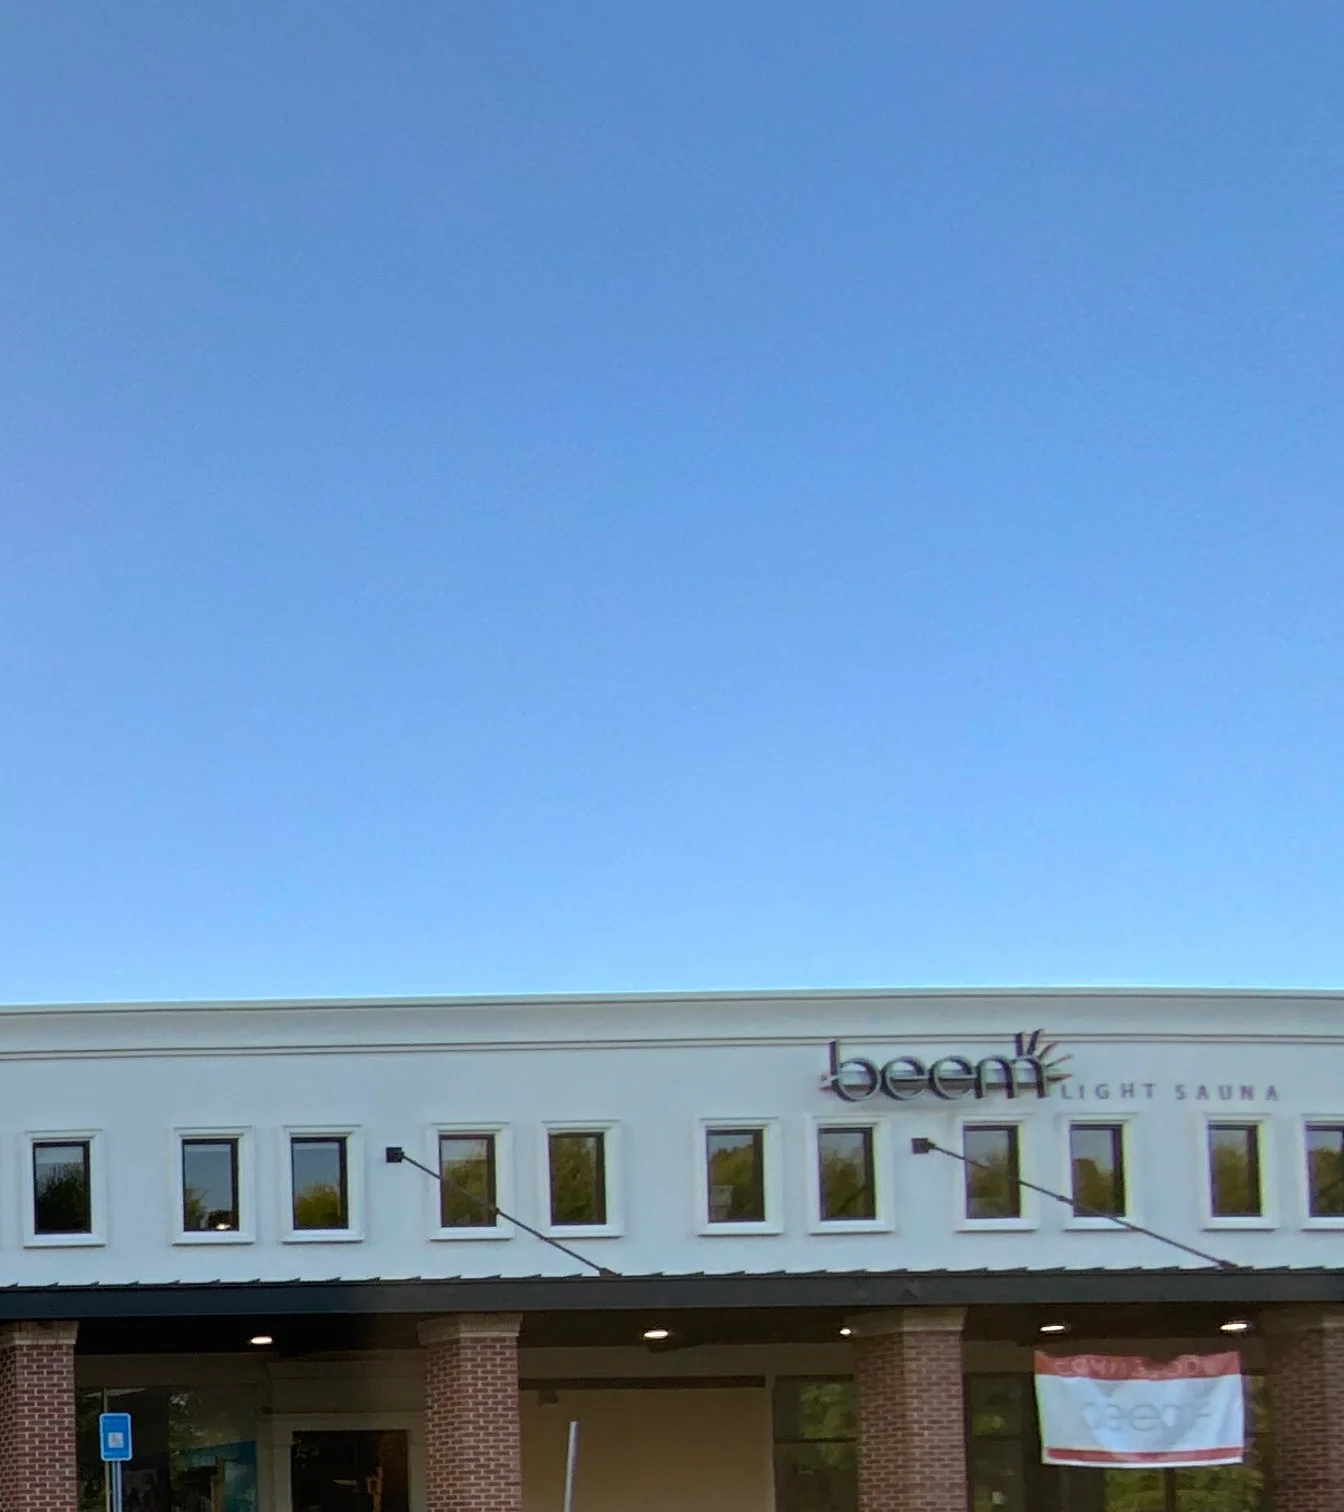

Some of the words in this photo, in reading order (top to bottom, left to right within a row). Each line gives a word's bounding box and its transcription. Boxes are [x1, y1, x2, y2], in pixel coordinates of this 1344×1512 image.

[825, 1037, 1052, 1103] beem
[1060, 1082, 1157, 1100] LIGHT
[1174, 1083, 1280, 1101] SAUNA
